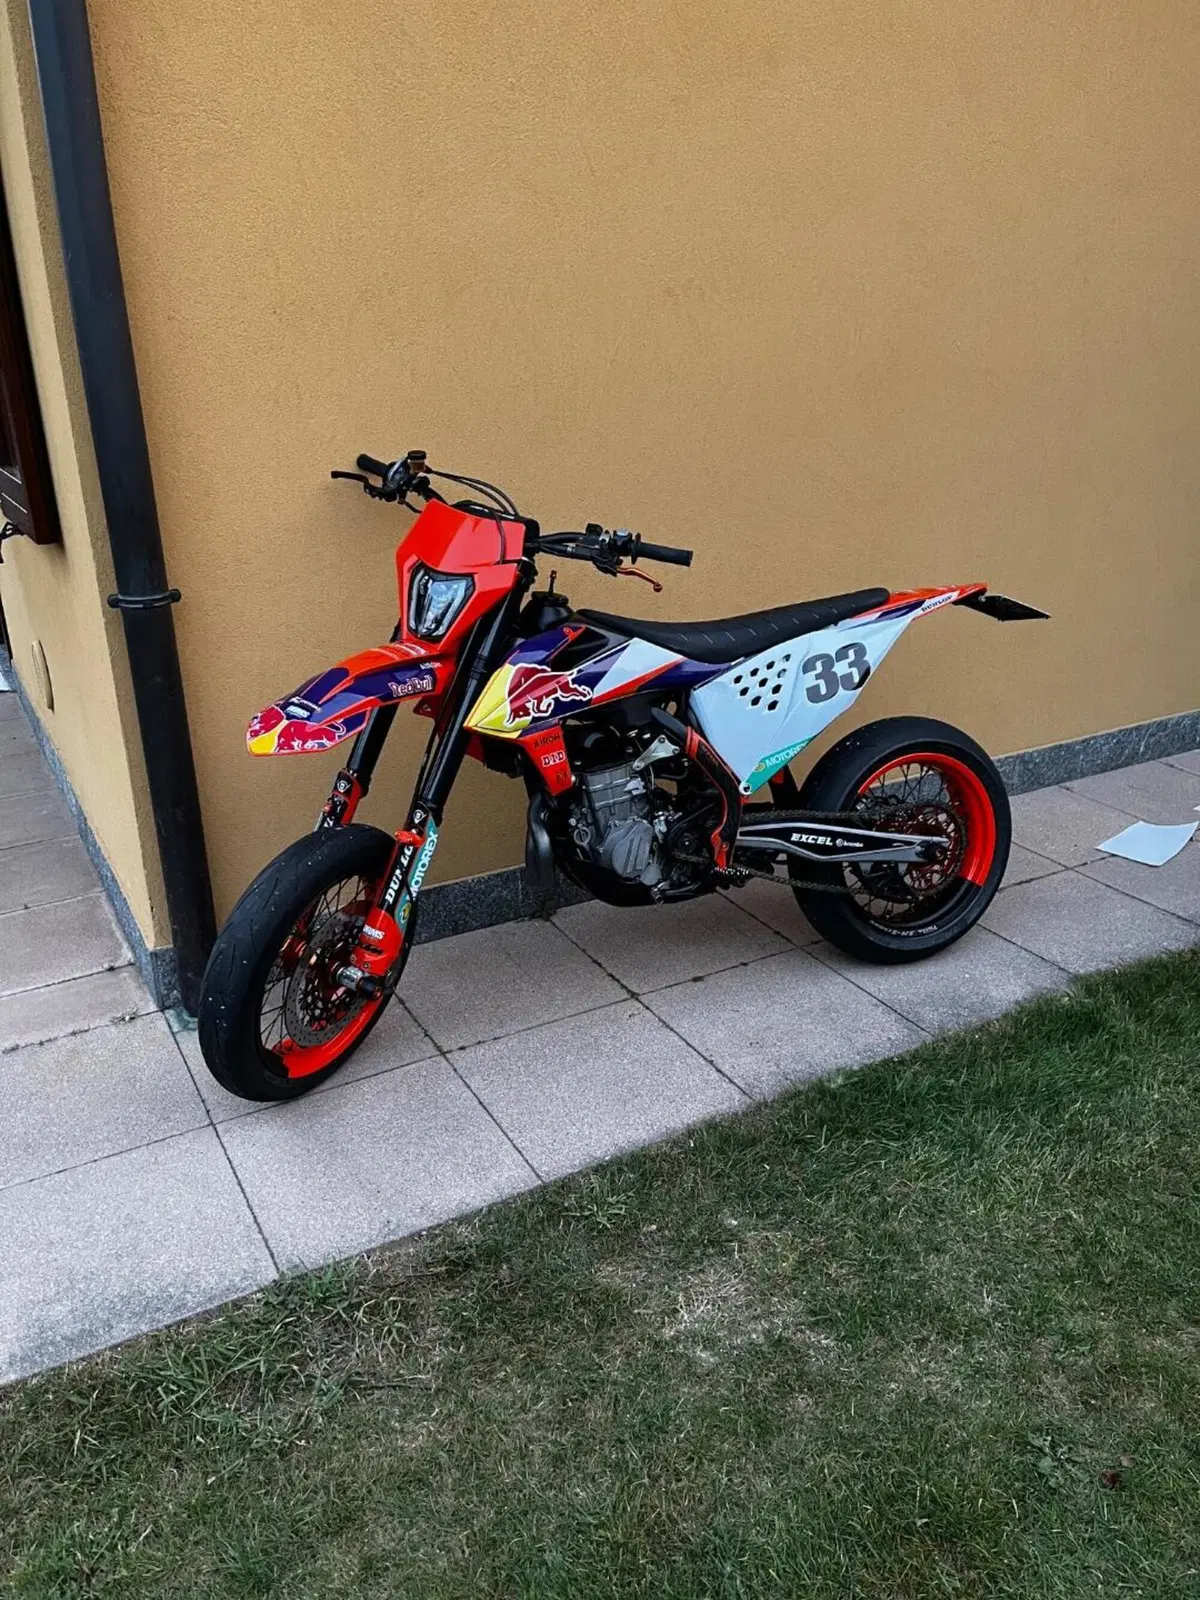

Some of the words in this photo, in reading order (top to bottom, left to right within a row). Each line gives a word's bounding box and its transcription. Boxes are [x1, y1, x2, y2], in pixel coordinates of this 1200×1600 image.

[802, 642, 871, 704] 33
[388, 678, 414, 698] Red
[410, 674, 433, 693] Bull
[791, 832, 833, 846] EXCEL
